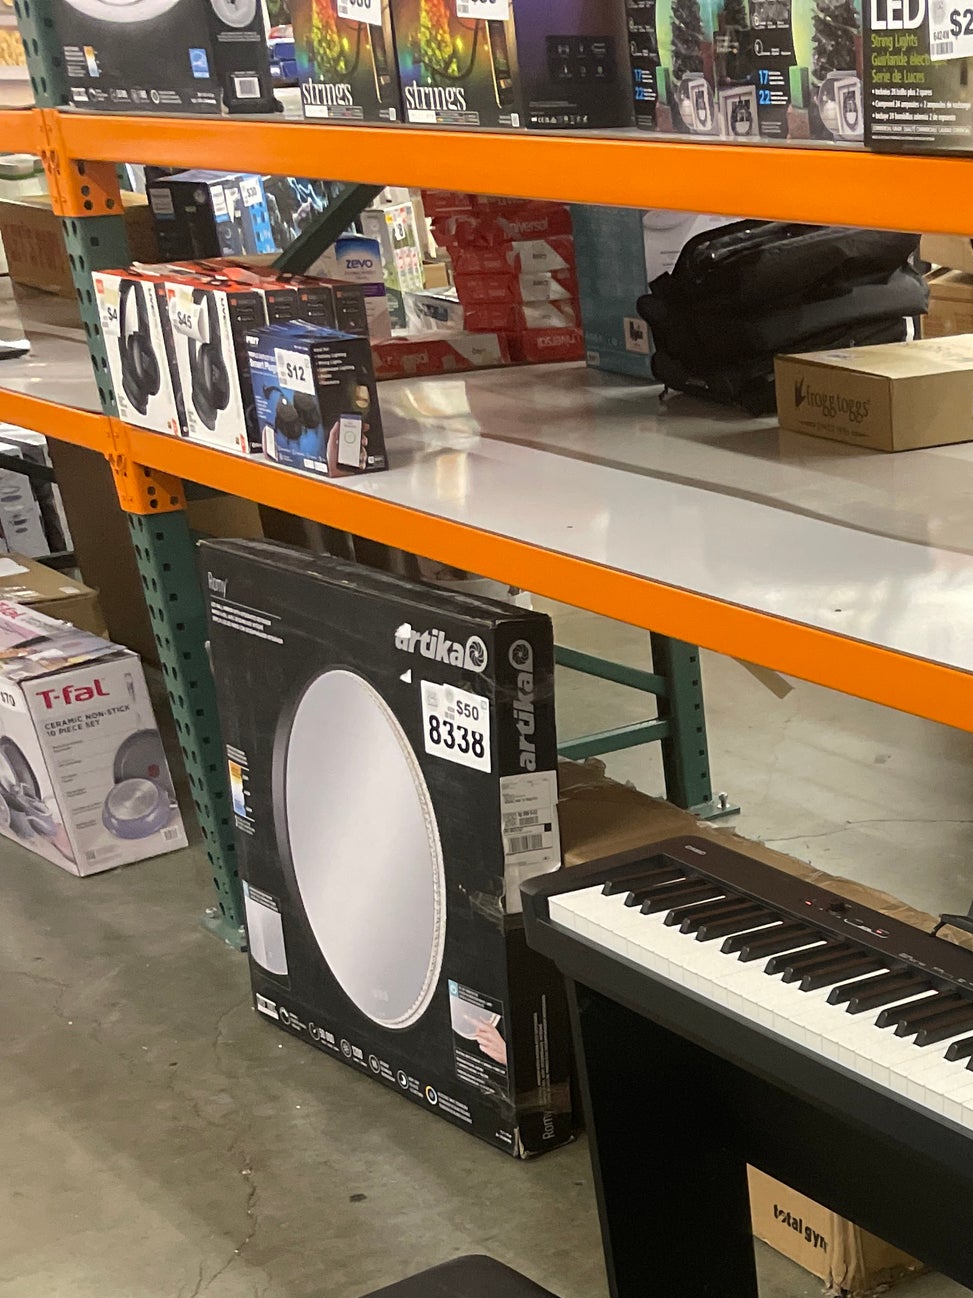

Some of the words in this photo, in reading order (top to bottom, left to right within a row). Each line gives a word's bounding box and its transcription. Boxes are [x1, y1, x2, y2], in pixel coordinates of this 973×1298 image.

[759, 70, 769, 85] 17
[302, 78, 354, 106] strings
[404, 80, 467, 111] strings
[759, 90, 770, 105] 22
[286, 362, 306, 381] $12
[35, 678, 110, 710] T-fal
[44, 714, 83, 731] CERAMIC
[85, 703, 131, 720] NON-STICK
[456, 700, 479, 721] $50
[513, 671, 537, 772] artika
[58, 723, 83, 735] PIECE
[85, 719, 101, 730] SET
[428, 714, 486, 759] 8338
[773, 1204, 803, 1235] total
